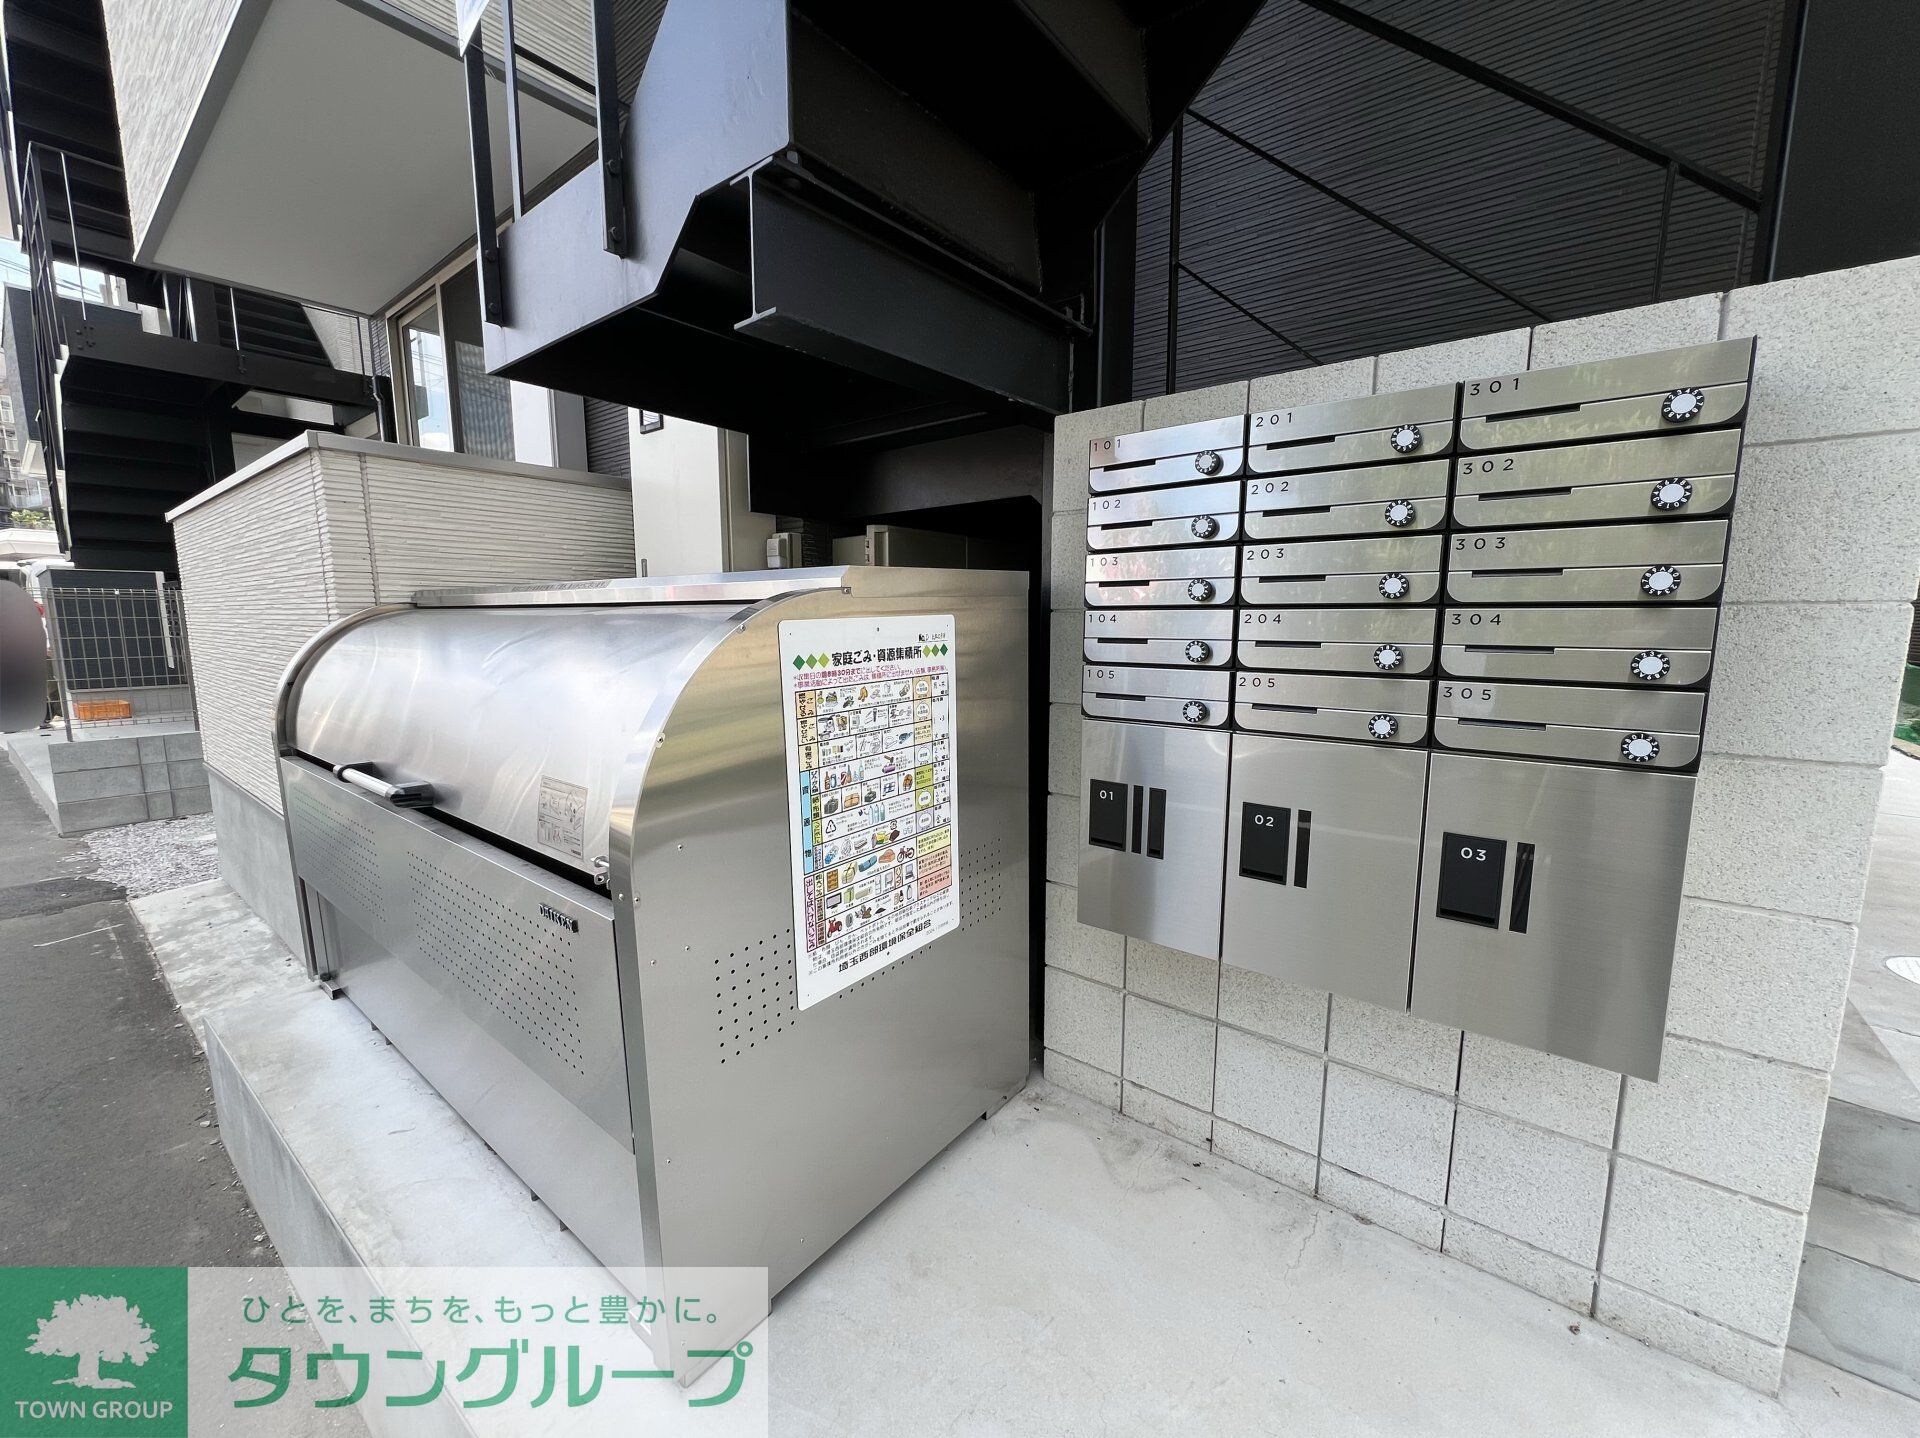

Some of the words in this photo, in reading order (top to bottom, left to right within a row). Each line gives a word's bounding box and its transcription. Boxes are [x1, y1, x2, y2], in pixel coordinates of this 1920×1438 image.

[1469, 377, 1520, 396] 301
[1255, 412, 1292, 428] 201
[1094, 438, 1121, 451] 101
[1462, 458, 1515, 475] 302
[1251, 481, 1289, 495] 202
[1092, 499, 1121, 511] 102
[1455, 536, 1506, 551] 303
[1246, 548, 1284, 561] 203
[1091, 556, 1118, 567] 103
[1088, 614, 1117, 624] 104
[1244, 613, 1282, 625] 204
[1451, 613, 1502, 626] 304
[831, 646, 922, 667] 家庭ごみ・資源集積所
[1087, 669, 1115, 680] 105
[1239, 677, 1275, 688] 205
[1443, 686, 1492, 700] 305
[1099, 790, 1114, 801] 01
[1254, 814, 1274, 828] 02
[1460, 846, 1487, 862] 03
[839, 919, 931, 973] 埼玉西部環境保全組合
